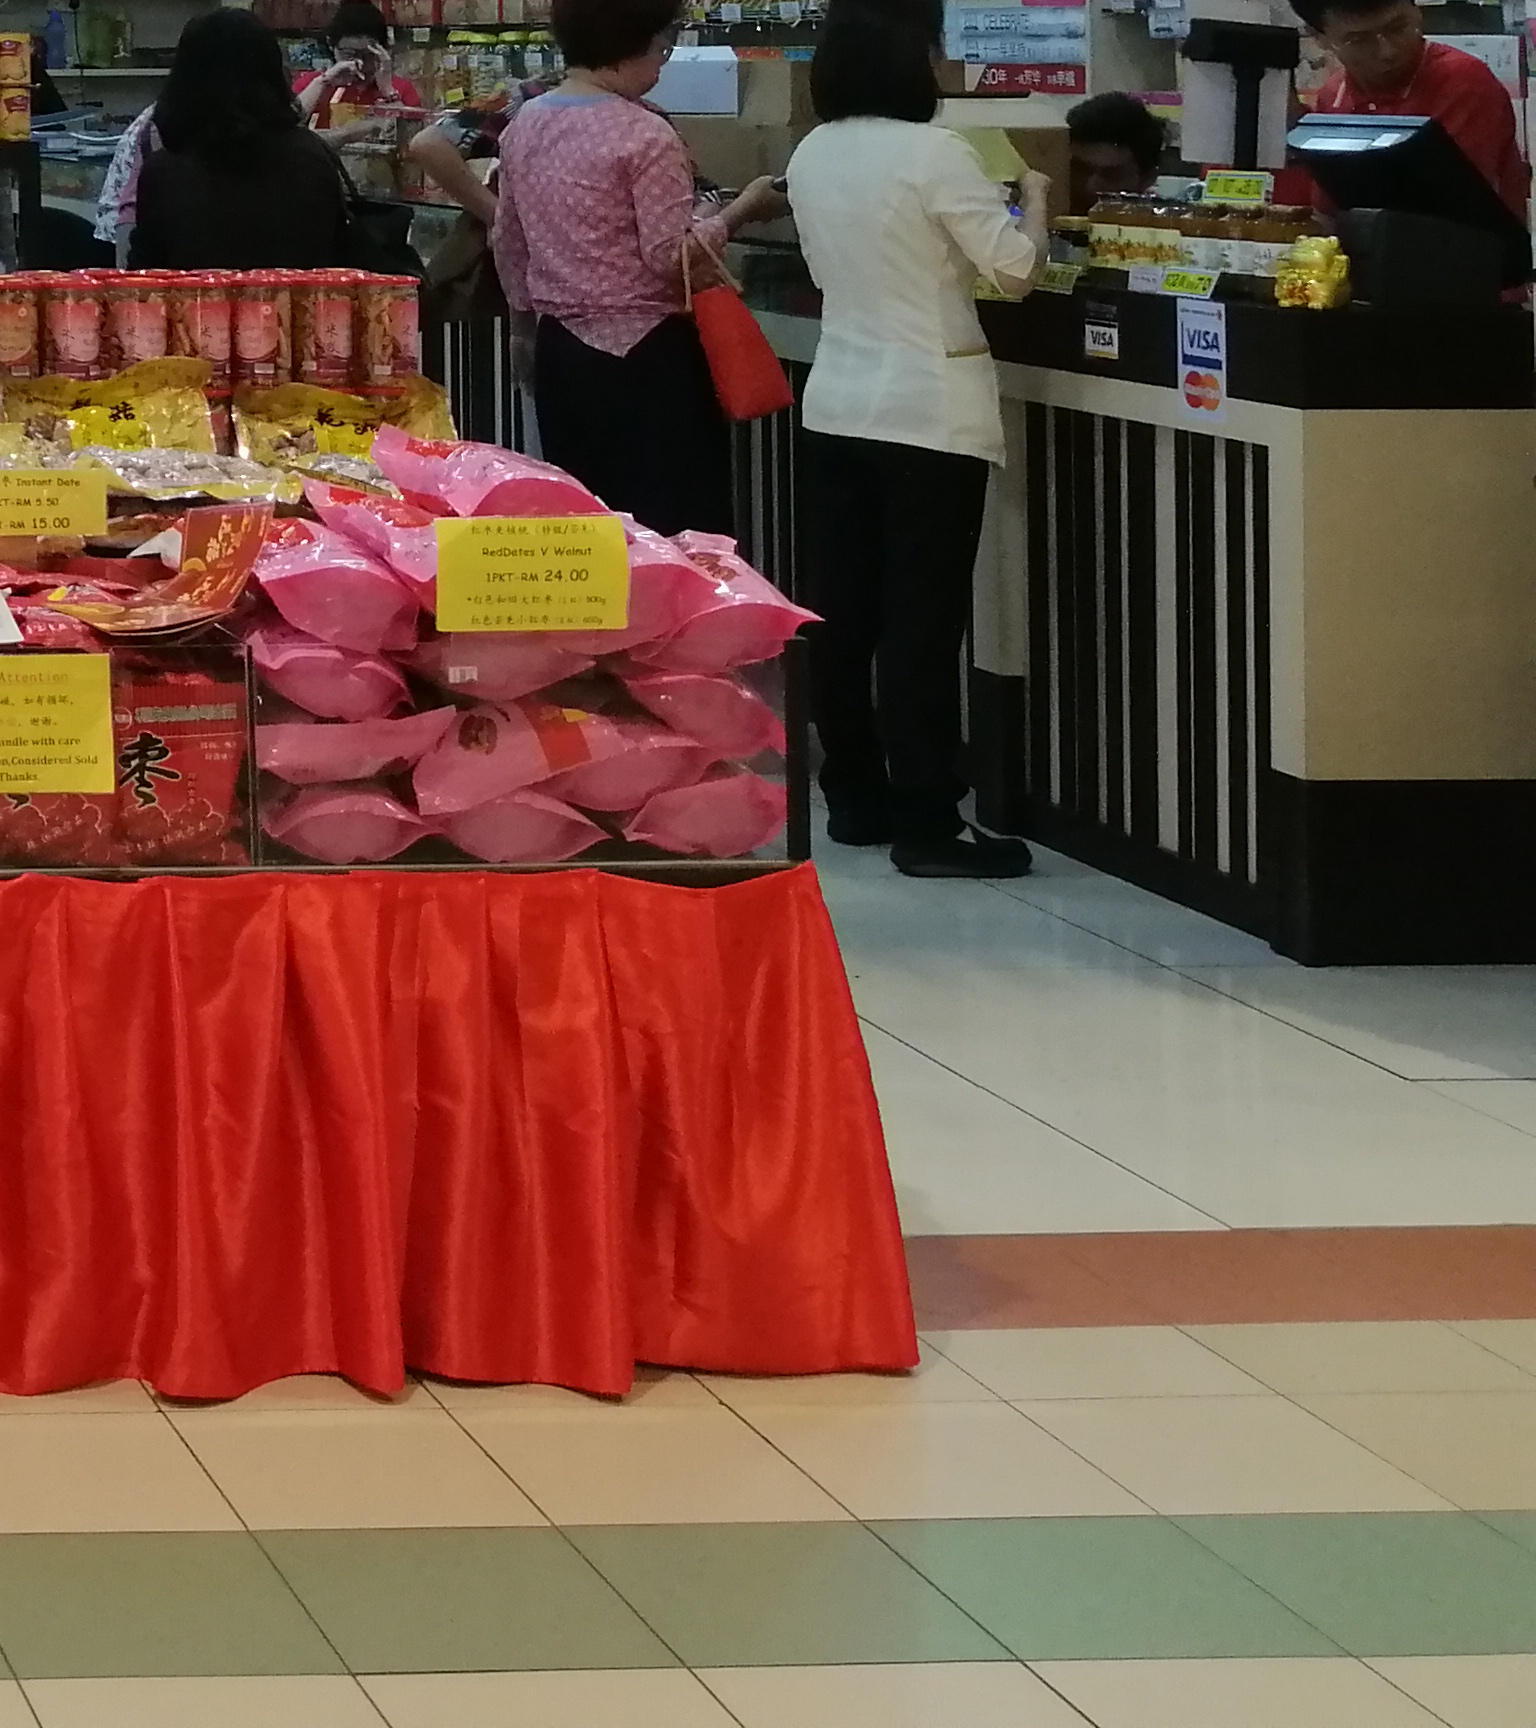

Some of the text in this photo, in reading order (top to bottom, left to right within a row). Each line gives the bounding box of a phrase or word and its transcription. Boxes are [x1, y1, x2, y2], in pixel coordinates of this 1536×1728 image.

[1090, 329, 1115, 349] VISA
[1186, 328, 1221, 353] VISA
[15, 477, 54, 488] Instant
[56, 477, 82, 488] Date
[31, 517, 71, 530] 15.00
[482, 546, 593, 558] RedDates V Walnut
[544, 569, 589, 583] 24.00
[31, 736, 55, 747] with
[58, 737, 81, 747] care
[75, 754, 98, 766] Sold
